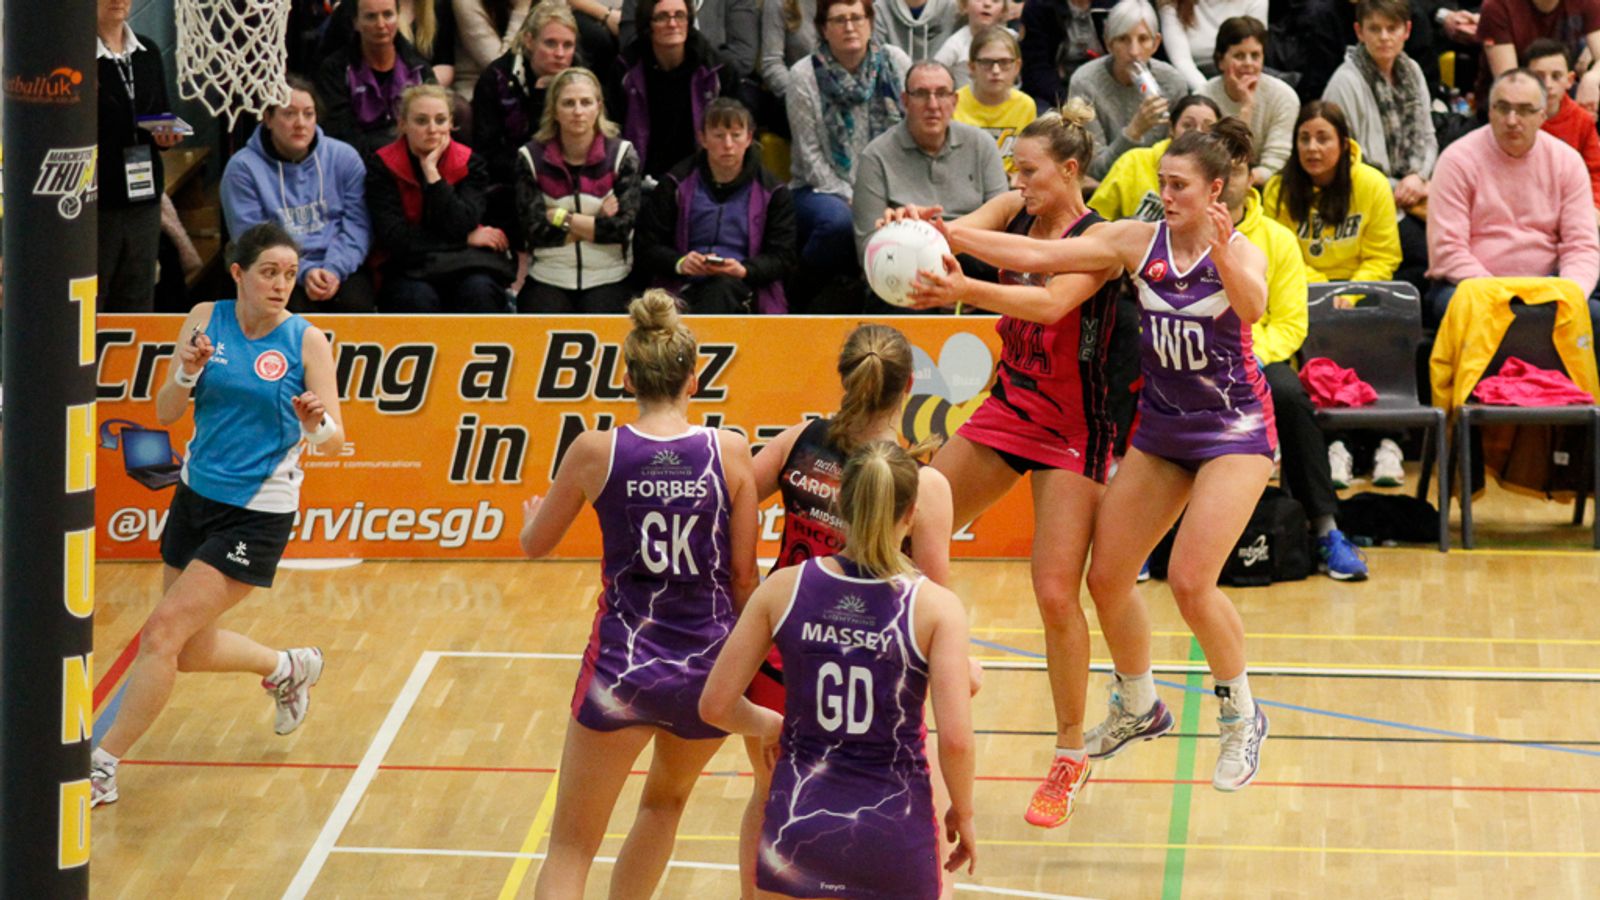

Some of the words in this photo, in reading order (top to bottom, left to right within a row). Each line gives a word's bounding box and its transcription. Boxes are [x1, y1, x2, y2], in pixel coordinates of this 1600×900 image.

[1001, 317, 1051, 375] WA
[1079, 316, 1098, 362] VUE
[1149, 315, 1208, 371] WD
[95, 329, 437, 414] Crng
[458, 342, 515, 402] a
[535, 329, 736, 401] Buz
[448, 413, 528, 484] in
[626, 480, 708, 498] FORBES
[641, 511, 700, 575] GK
[801, 622, 893, 653] MASSEY
[816, 661, 874, 735] GD
